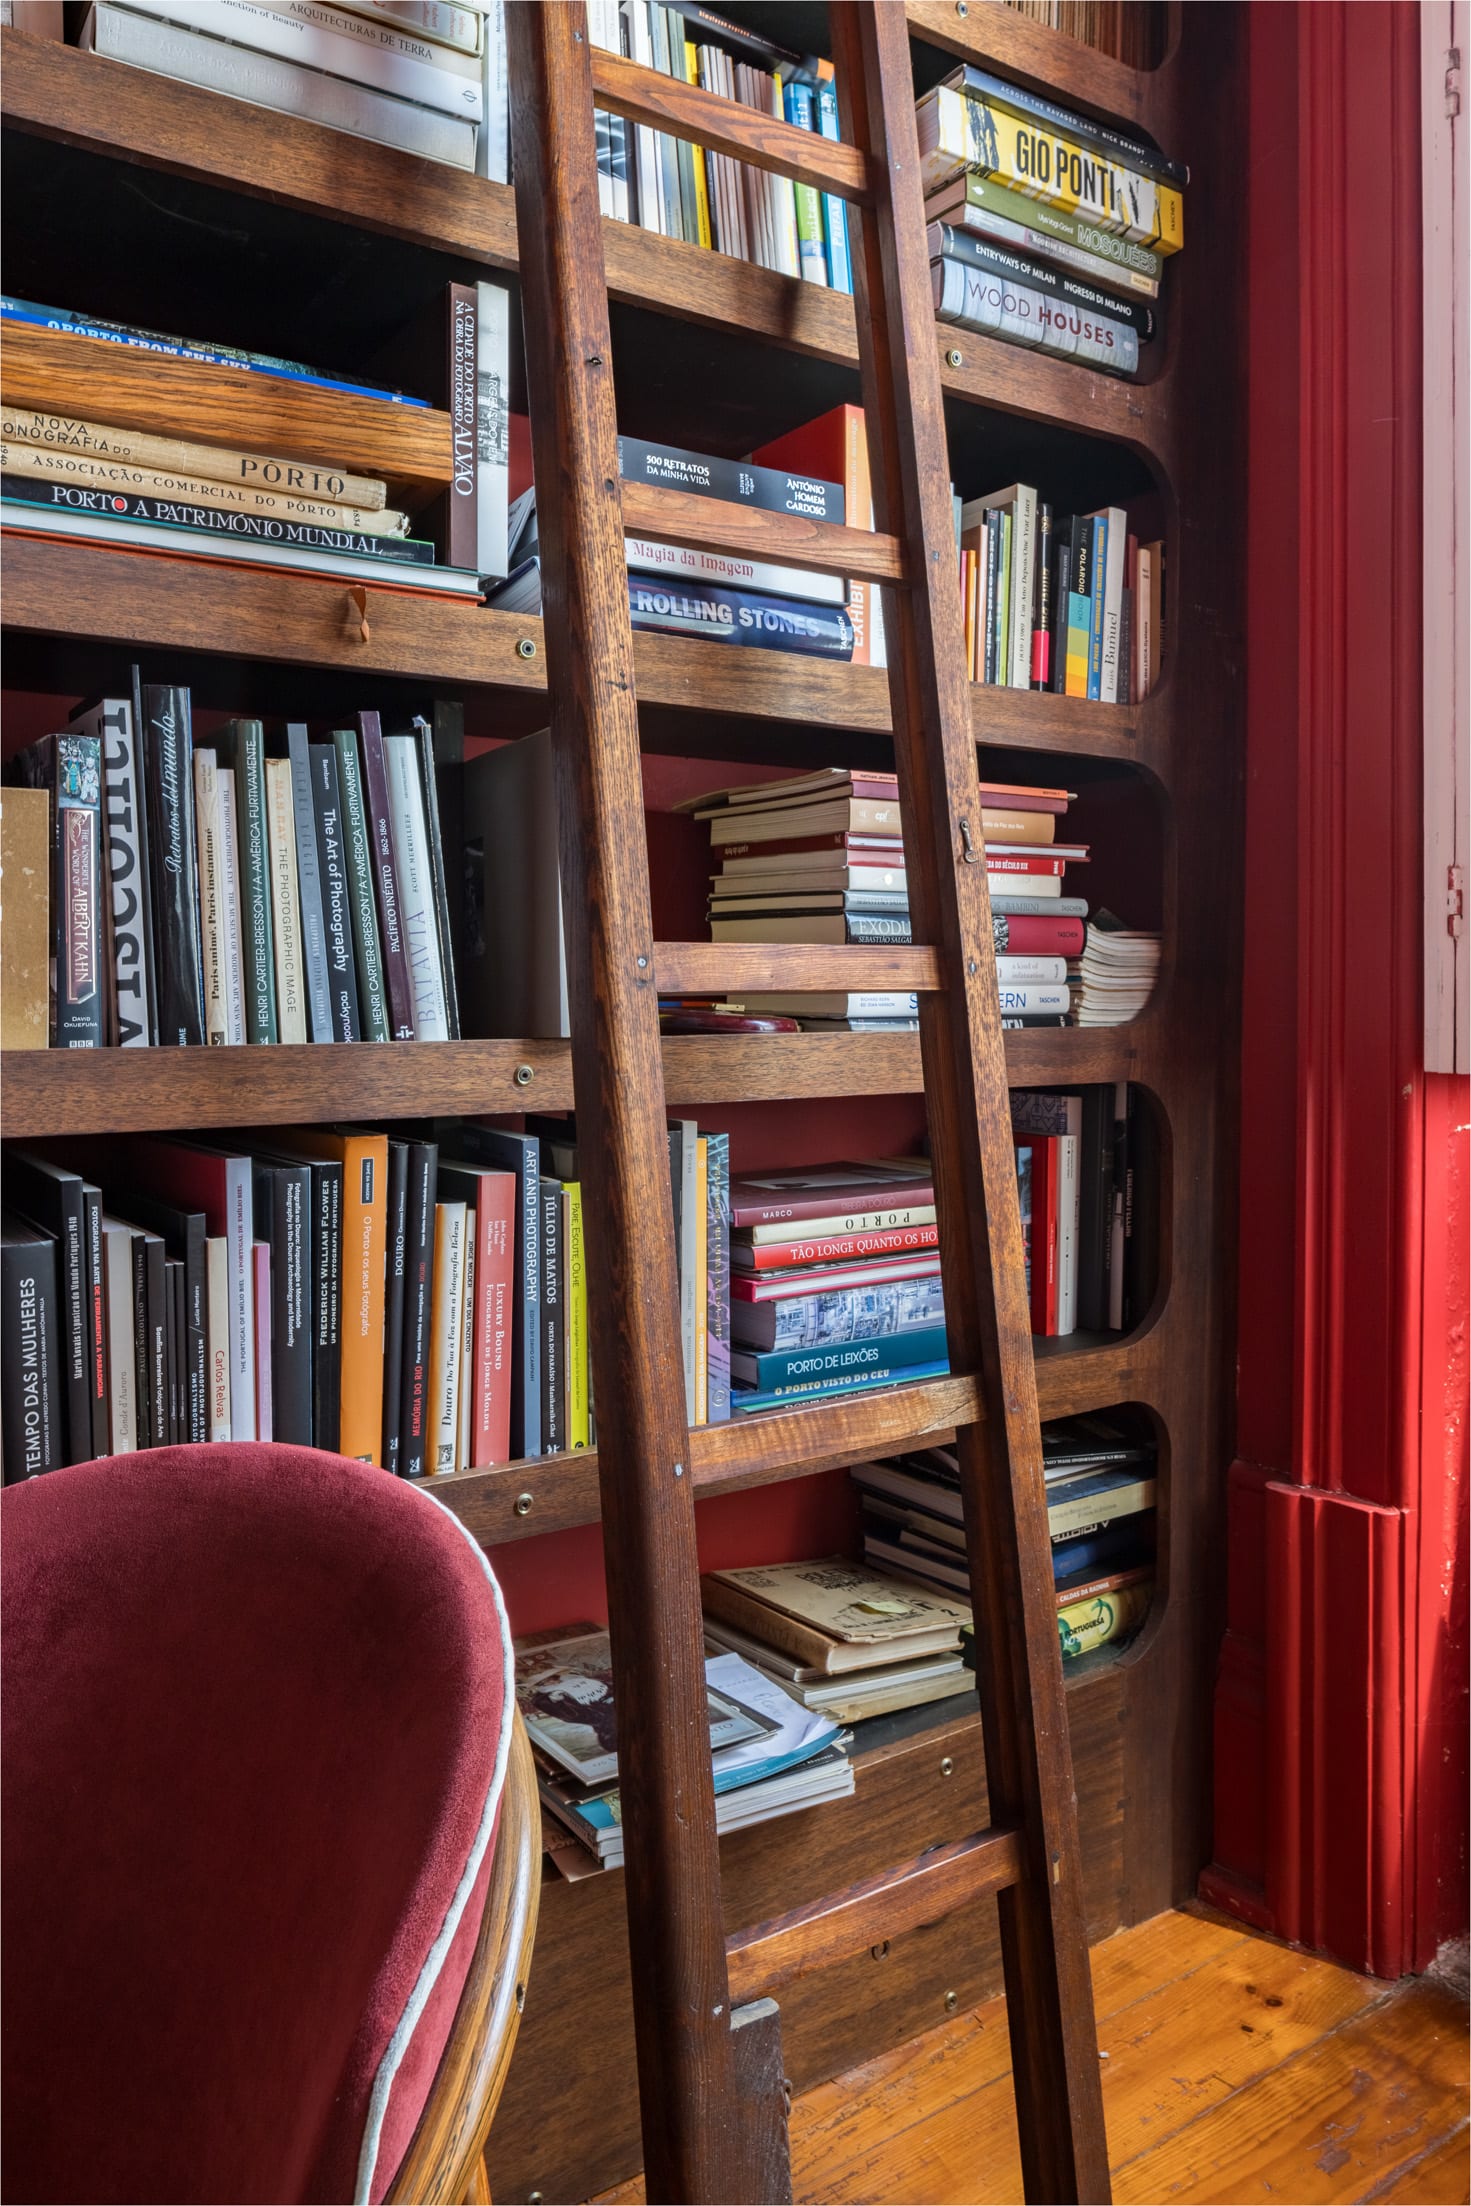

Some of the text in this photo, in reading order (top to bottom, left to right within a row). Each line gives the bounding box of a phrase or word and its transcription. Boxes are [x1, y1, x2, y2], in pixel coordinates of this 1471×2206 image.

[289, 2, 433, 60] ARQUITECTURAS DE TERRA
[1000, 86, 1145, 155] ACROSS THE RAVAGED LAND NICK BRANDT
[1016, 130, 1116, 211] GIO PONTI
[1077, 224, 1157, 274] MOSQUÉES
[975, 243, 1020, 270] ENTRYWAYS
[1020, 262, 1031, 275] OF
[1031, 265, 1056, 286] MILAN
[1063, 280, 1096, 302] INGRESSI
[1096, 293, 1104, 305] DI
[1104, 296, 1132, 317] MILANO
[455, 299, 464, 315] NA
[968, 279, 1114, 348] WOOD HOUSES
[455, 317, 464, 344] OBRA
[455, 346, 464, 362] DO
[463, 303, 475, 424] A CIDADE DO PORTO
[34, 415, 89, 436] NOVA
[3, 422, 345, 495] ONOGRAFIA DO PÔRTO
[454, 421, 474, 496] ALVÃO
[646, 454, 710, 476] 500 RETRATOS
[646, 465, 710, 486] DA MINHA VIDA
[32, 455, 336, 518] ASSOCIAÇÃO COMERCIAL DO PÔRTO
[786, 478, 825, 495] ANTÓNIO
[786, 500, 826, 516] CARDOSO
[794, 491, 825, 505] HOMEM
[51, 485, 384, 554] PORTO A PATRIMÓNIO MUNDIAL
[633, 542, 754, 579] Magia da Imagem
[1078, 548, 1087, 594] POLAROID
[636, 590, 820, 638] ROLLING STONES
[1104, 610, 1118, 665] Buñuel
[151, 710, 183, 874] Retratos del mundo
[324, 808, 336, 835] The
[71, 848, 81, 887] WORLD OF
[80, 828, 89, 887] THE WONDERFUL
[325, 838, 339, 860] Art
[328, 863, 342, 878] of
[246, 740, 269, 1027] HENRI CARTIER-BRESSON A AMÉRICA FURTIVAMENTE
[344, 751, 383, 1025] HENRI CARTIER-BRESSON A AMÉRICA FURTIVAMENTE
[379, 818, 400, 953] PACÍFICO INÉDITO 1862-1866
[72, 888, 92, 984] ALBERT KAHN
[278, 848, 297, 1013] THE PHOTOGRAPHIC IMAGE
[329, 881, 349, 972] Photography
[858, 934, 889, 944] SEBASTIÃO
[859, 919, 912, 936] EXODU
[406, 910, 437, 1023] BATAVIA
[1039, 996, 1060, 1004] TASCHEN
[91, 1206, 101, 1250] FOTOGRAFIA
[363, 1216, 372, 1224] O
[525, 1149, 538, 1302] ART AND PHOTOGRAPHY
[762, 1209, 793, 1219] MARCO
[845, 1212, 910, 1230] PORTO
[92, 1253, 101, 1264] NA
[363, 1226, 372, 1250] Porto
[395, 1235, 405, 1276] DOURO
[543, 1195, 557, 1304] JÚLIO DE MATOS
[571, 1202, 581, 1287] PARE, ESCUTE, OLHE
[790, 1234, 918, 1261] TÃO LONGE QUANTO OS
[92, 1266, 101, 1285] ARTE
[319, 1180, 330, 1346] FREDERICK WILLIAM FLOWER
[362, 1258, 369, 1269] os
[94, 1285, 102, 1296] DE
[360, 1291, 371, 1337] Fotógrafos
[495, 1283, 506, 1371] LUXURY BOUND
[20, 1277, 42, 1473] TEMPO DAS MULHERES
[483, 1284, 494, 1432] FOTOGRAFIAS DE JORGE MOLDER
[787, 1347, 879, 1376] PORTO DE LEIXÕES
[215, 1349, 227, 1419] Carlos Relvas
[412, 1365, 423, 1437] MEMÓRIA DO RIO
[774, 1386, 783, 1396] O
[784, 1381, 821, 1395] PORTO
[822, 1376, 851, 1387] VISTO
[854, 1372, 869, 1383] DO
[1059, 1591, 1080, 1602] CALDAS
[1065, 1617, 1105, 1637] PORTUGUESA
